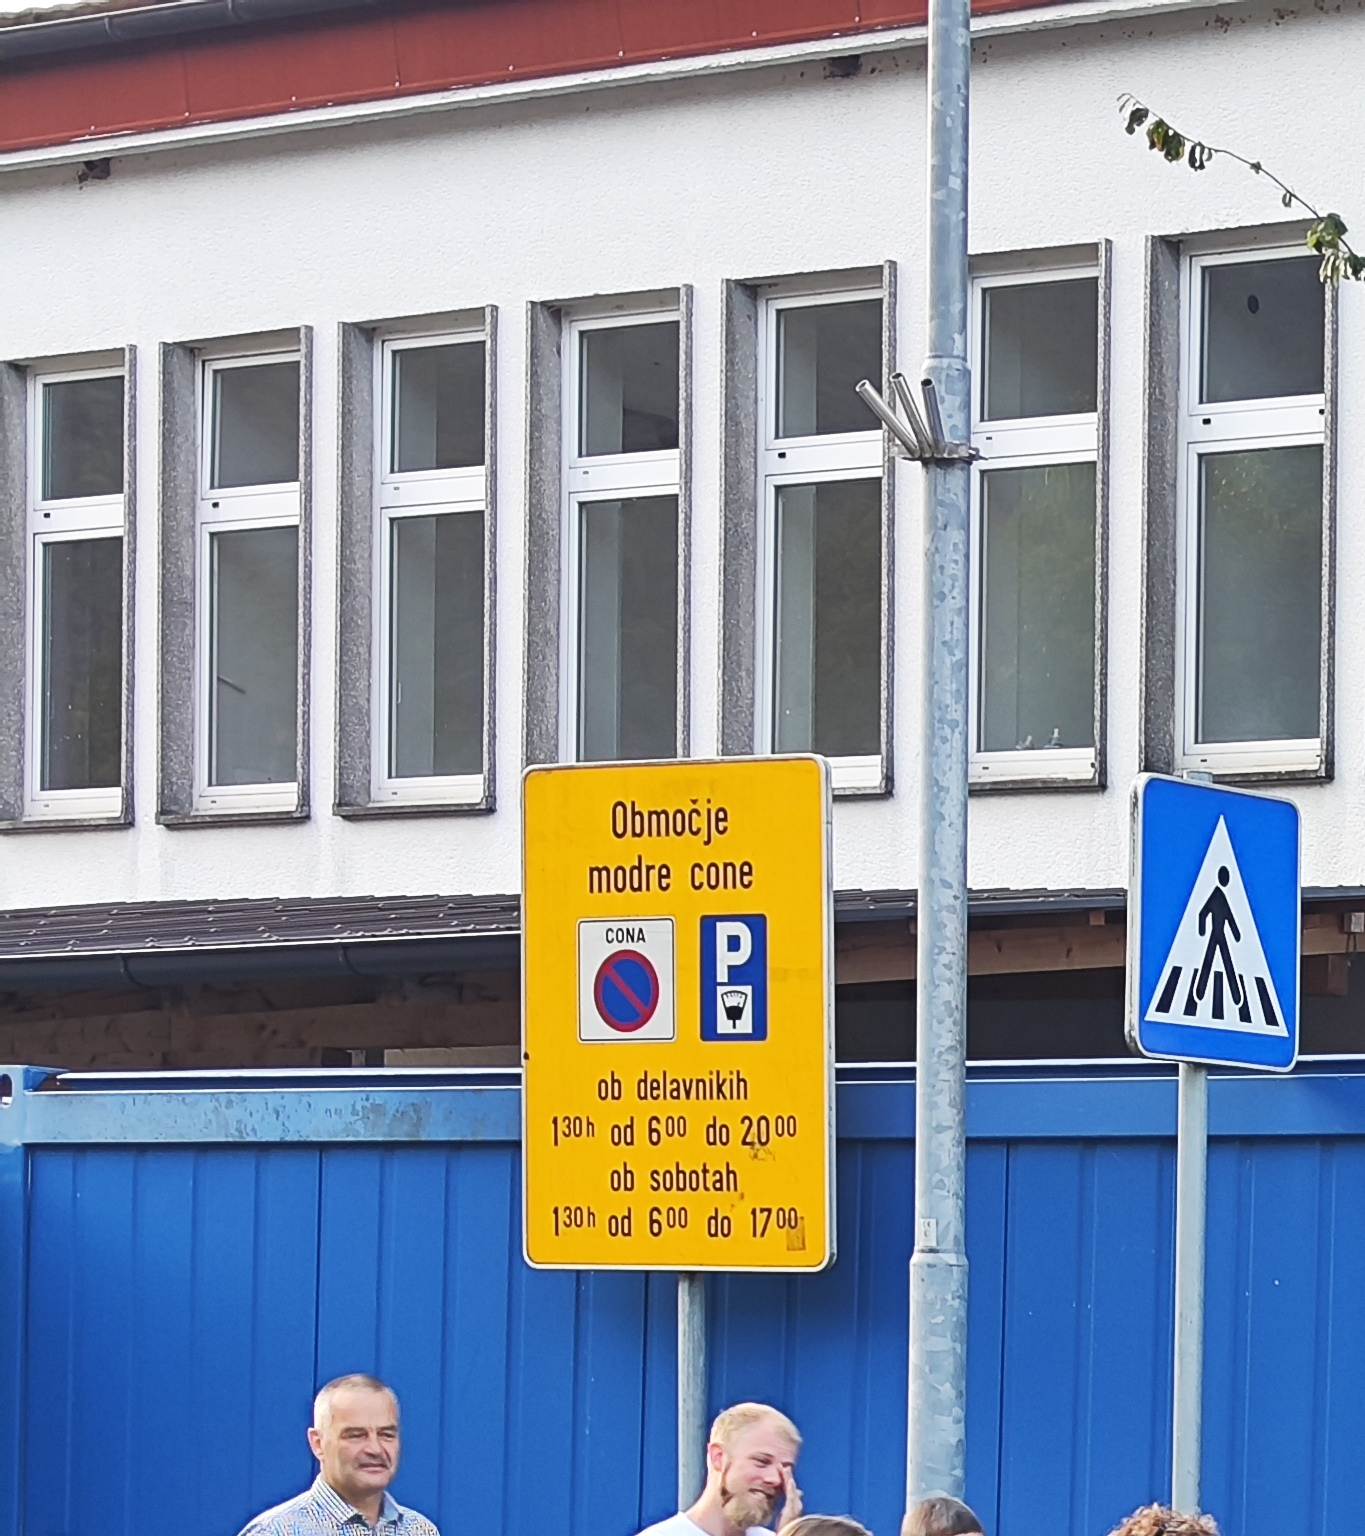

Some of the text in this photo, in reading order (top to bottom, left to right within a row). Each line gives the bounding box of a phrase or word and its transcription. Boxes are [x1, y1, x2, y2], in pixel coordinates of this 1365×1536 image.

[611, 797, 729, 847] Območje
[588, 853, 754, 894] modre cone
[605, 927, 647, 944] CONA
[716, 921, 752, 983] P
[597, 1069, 749, 1101] ob delavnikih
[610, 1115, 635, 1147] od
[705, 1115, 730, 1147] do
[610, 1161, 739, 1192] ob sobotah
[608, 1206, 632, 1237] od
[707, 1207, 732, 1238] do
